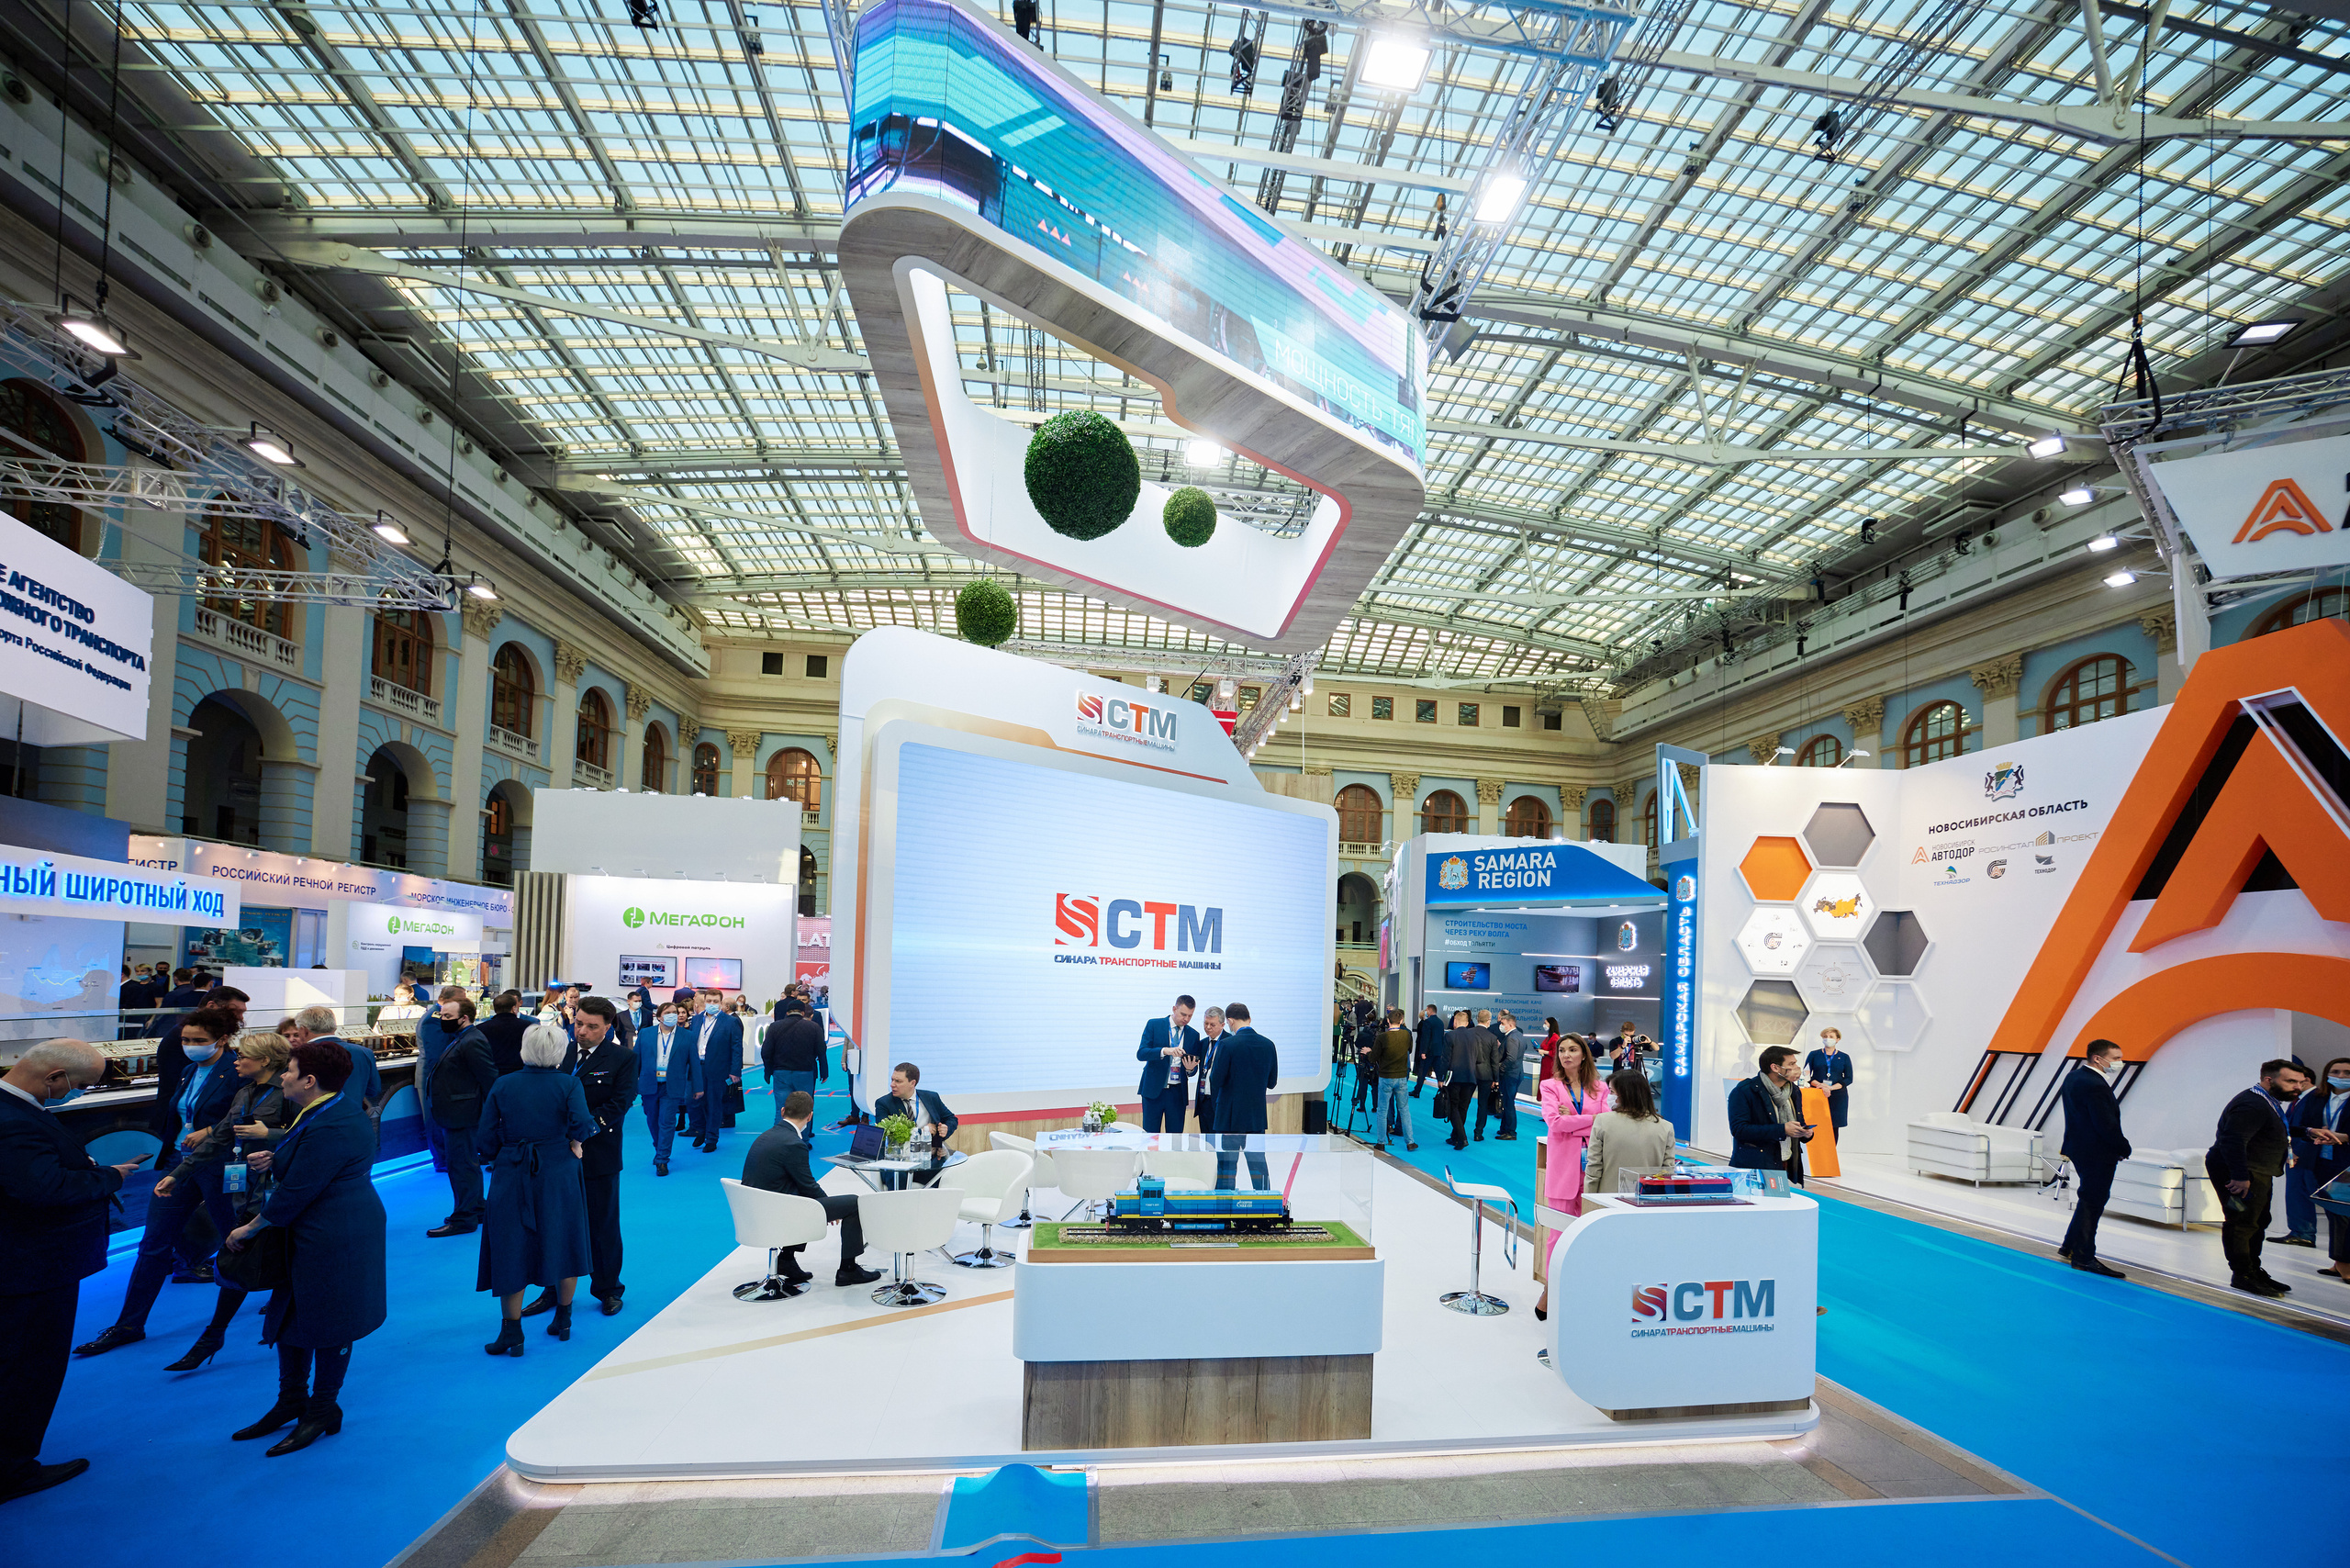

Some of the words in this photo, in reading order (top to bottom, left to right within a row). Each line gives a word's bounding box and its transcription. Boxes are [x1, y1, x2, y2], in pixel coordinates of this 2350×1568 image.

[1275, 338, 1382, 421] МОЩНОСТЬ
[7, 570, 95, 624] АГЕНТСТВО
[63, 620, 146, 672] ТРАНСПОРТА
[25, 636, 83, 671] Российской
[84, 662, 132, 691] Федерации
[1107, 699, 1178, 741] СТМ
[1928, 809, 2026, 835] НОВОСИБИРСКАЯ
[2028, 799, 2088, 818] ОБЛАСТЬ
[1931, 839, 1975, 851] НОВОСИБИРСК
[1931, 846, 1975, 862] АВТОДОР
[1978, 840, 2034, 855] РОСИНСТАЛ
[2056, 831, 2099, 844] ПРОЕКТ
[1473, 851, 1557, 872] SAMARA
[212, 865, 290, 886] РОССИЙСКИЙ
[293, 876, 333, 890] РЕЧНОЙ
[337, 882, 376, 896] РЕГИСТР
[1478, 870, 1551, 890] REGION
[1933, 878, 1971, 887] ТЕХНАДЗОР
[65, 872, 187, 910] ШИРОТНЫЙ
[192, 890, 224, 917] ХОД
[490, 903, 508, 913] БЮРО
[1106, 898, 1224, 954] СТМ
[1445, 919, 1504, 929] СТРОИТЕЛЬСТВО
[1504, 923, 1528, 931] МОСТА
[1445, 928, 1468, 936] ЧЕРЕЗ
[1469, 929, 1487, 937] РЕКУ
[1488, 930, 1510, 938] ВОЛГА
[1444, 938, 1468, 947] #ОБХОД
[1677, 906, 1693, 978] ОБЛАСТЬ
[1054, 954, 1097, 965] СИНАРА
[1099, 957, 1177, 969] ТРАНСПОРТНЫЕ
[1179, 961, 1221, 970] МАШИНЫ
[1606, 965, 1650, 977] САМАРСКАЯ
[1609, 976, 1643, 988] ОБЛАСТЬ
[1674, 981, 1690, 1077] САМАРСКАЯ
[1673, 1278, 1775, 1321] СТМ
